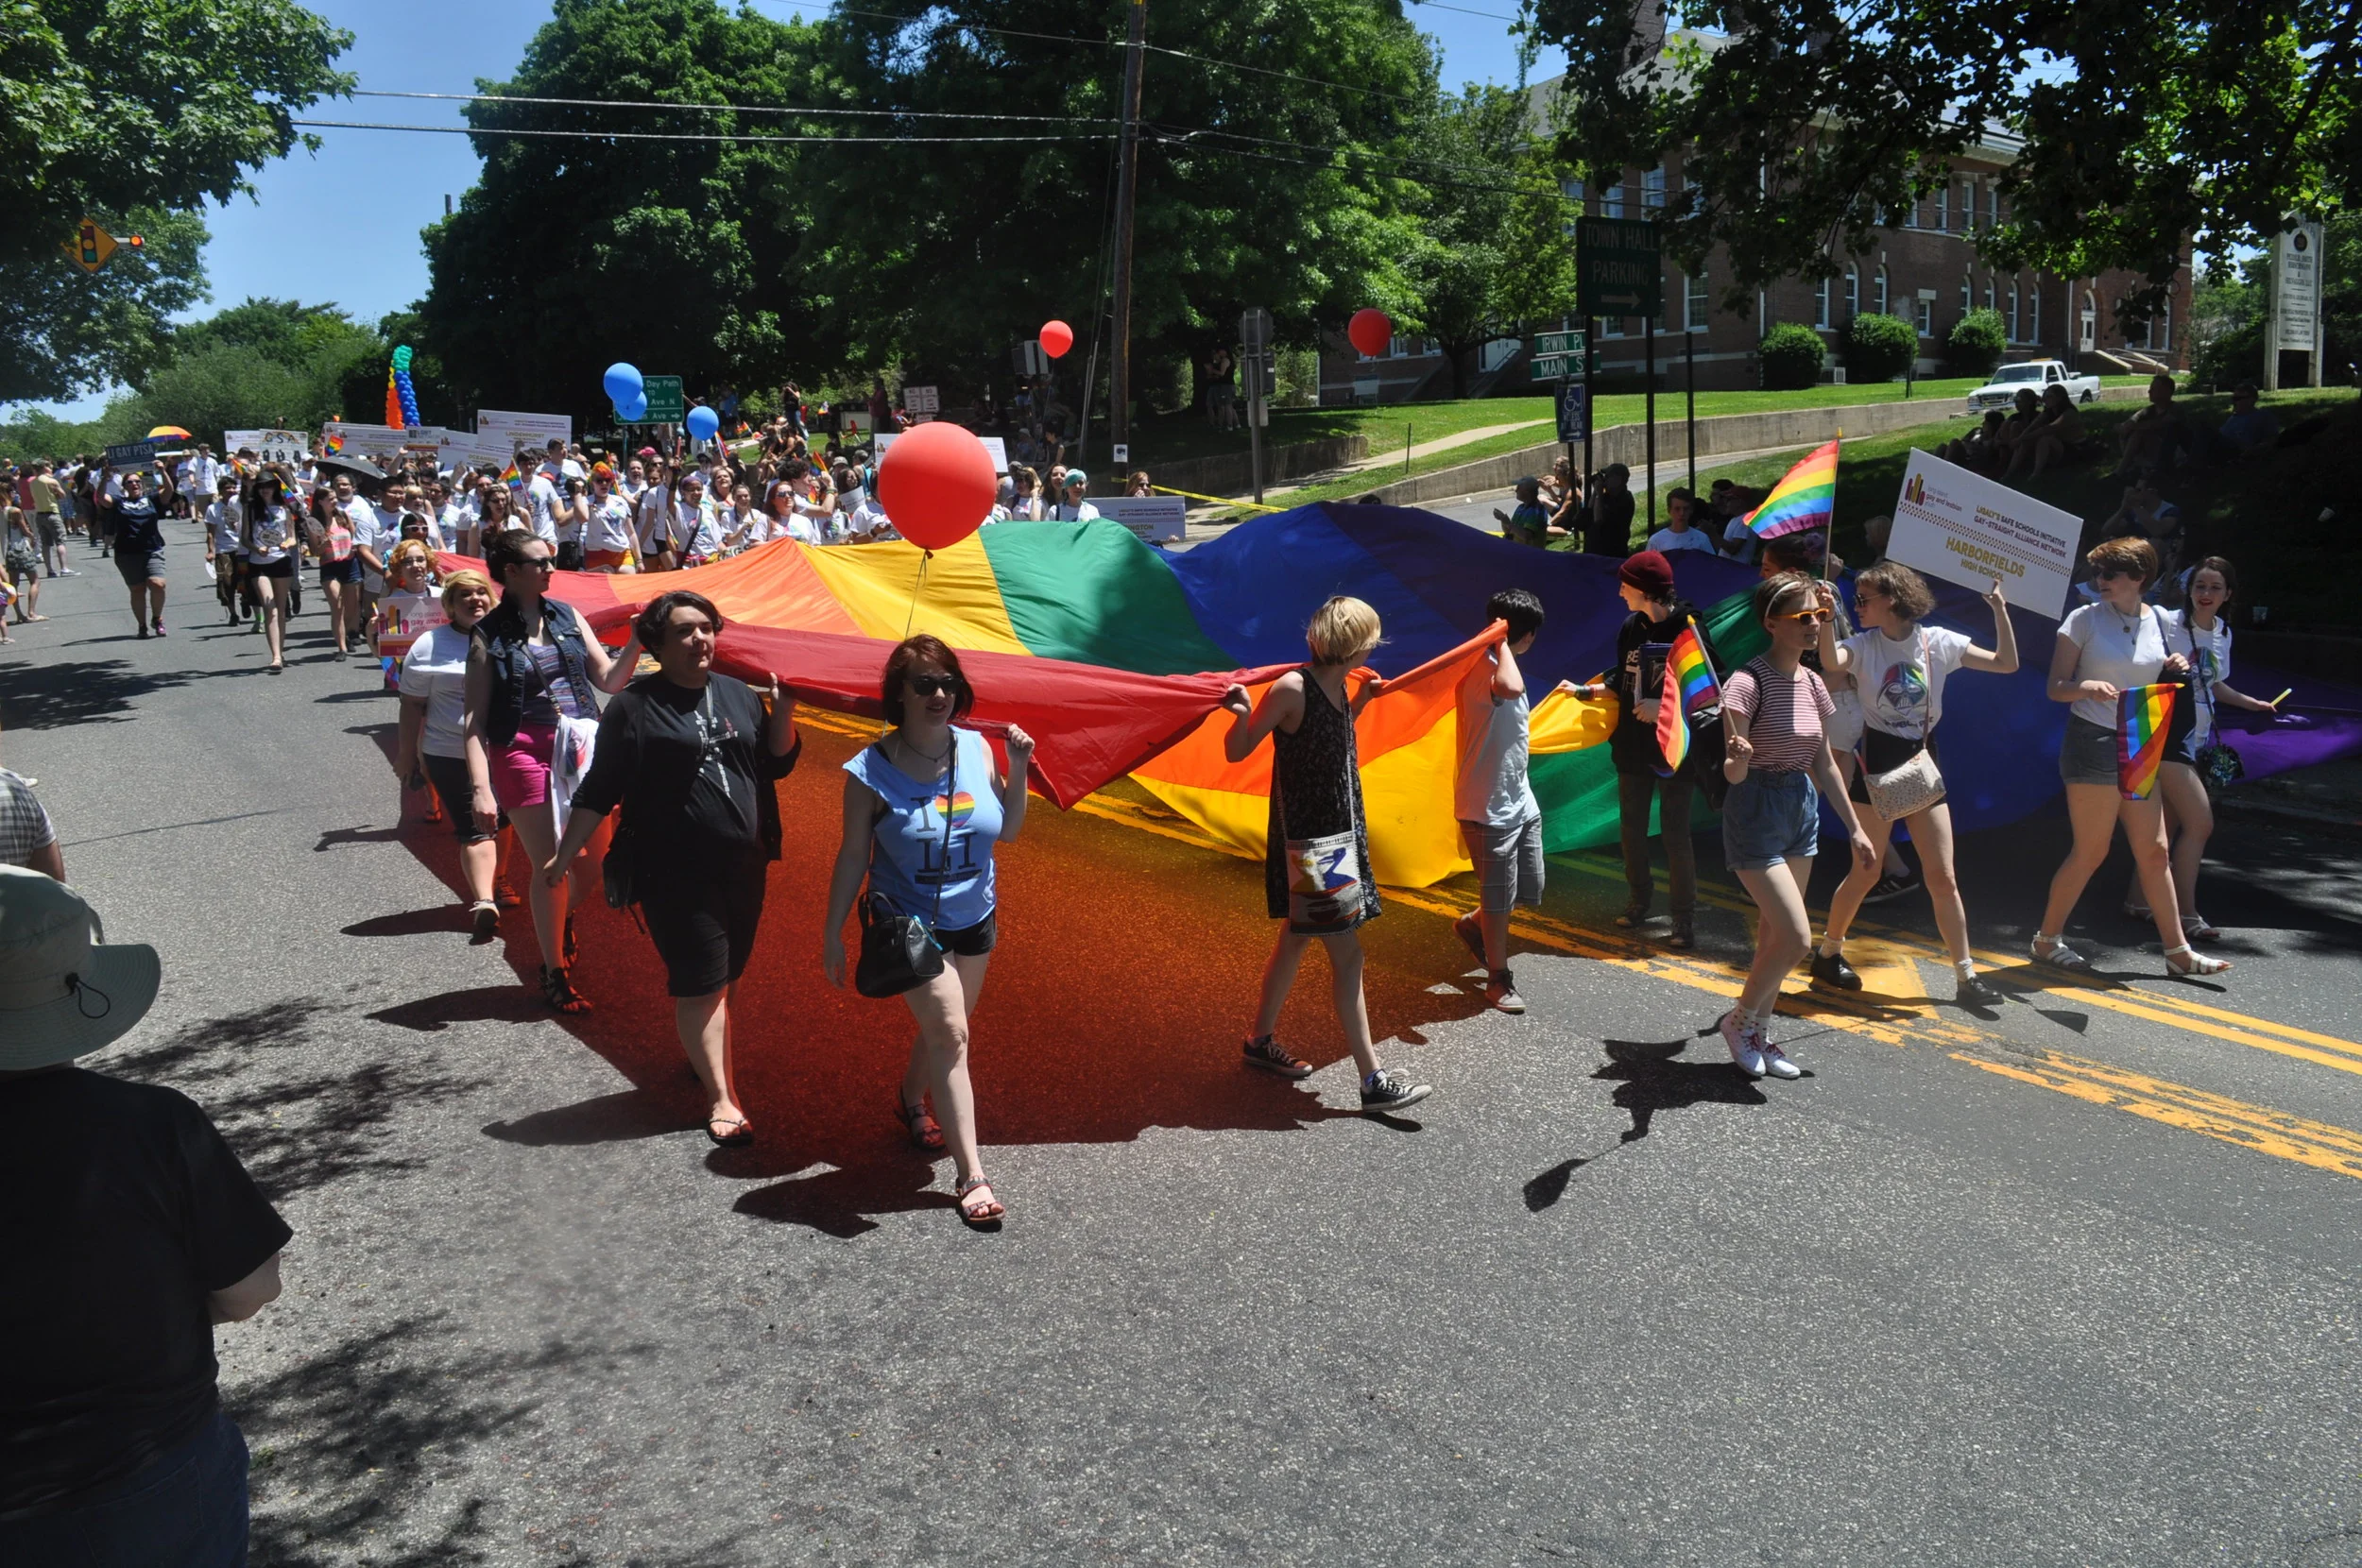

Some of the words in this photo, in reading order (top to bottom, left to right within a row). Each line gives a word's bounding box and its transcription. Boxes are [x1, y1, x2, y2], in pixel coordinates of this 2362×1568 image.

[1583, 223, 1619, 248] TOWN
[1626, 227, 1658, 252] HALL
[1592, 260, 1651, 286] PARKING
[1541, 334, 1568, 352] IRWIN
[1573, 333, 1586, 349] PL
[1540, 358, 1568, 377] MAIN
[1575, 355, 1586, 372] S
[646, 380, 660, 389] Day
[115, 446, 131, 458] GAY
[133, 443, 154, 455] PTSA
[1936, 497, 1946, 505] and
[2000, 515, 2015, 527] SAFE
[2014, 520, 2040, 537] SCHOOLS
[2039, 532, 2067, 549] INITIATIVE
[1945, 536, 2026, 578] HARBORFIELDS
[2014, 532, 2041, 547] ALLIANCE
[2040, 541, 2067, 558] NETWORK
[1960, 558, 1979, 573] HIGH
[1977, 565, 2005, 582] SCHOOL
[910, 795, 937, 833] I
